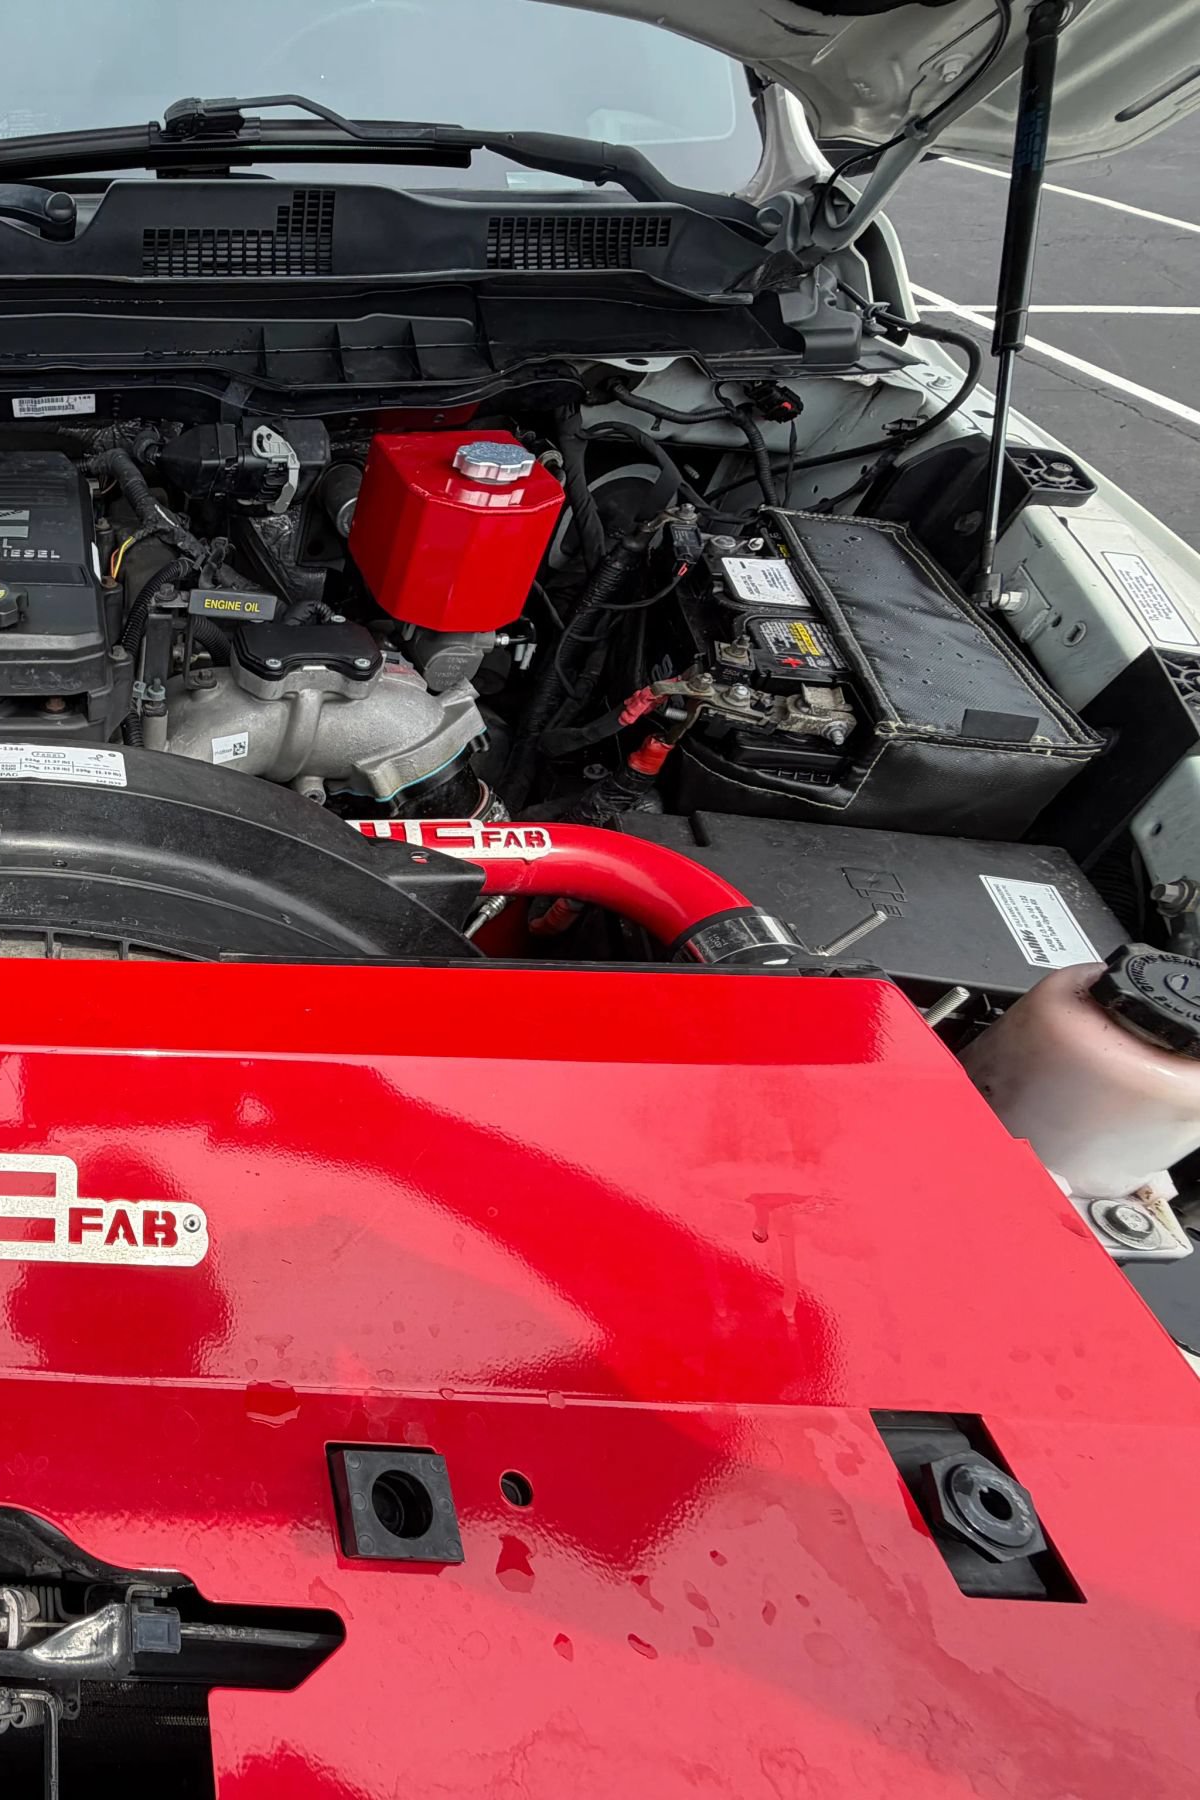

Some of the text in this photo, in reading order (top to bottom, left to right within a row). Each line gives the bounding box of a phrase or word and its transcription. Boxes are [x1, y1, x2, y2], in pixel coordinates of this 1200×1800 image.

[204, 599, 261, 613] ENGINE OIL
[481, 830, 547, 849] FAB
[68, 1206, 178, 1249] FAB
